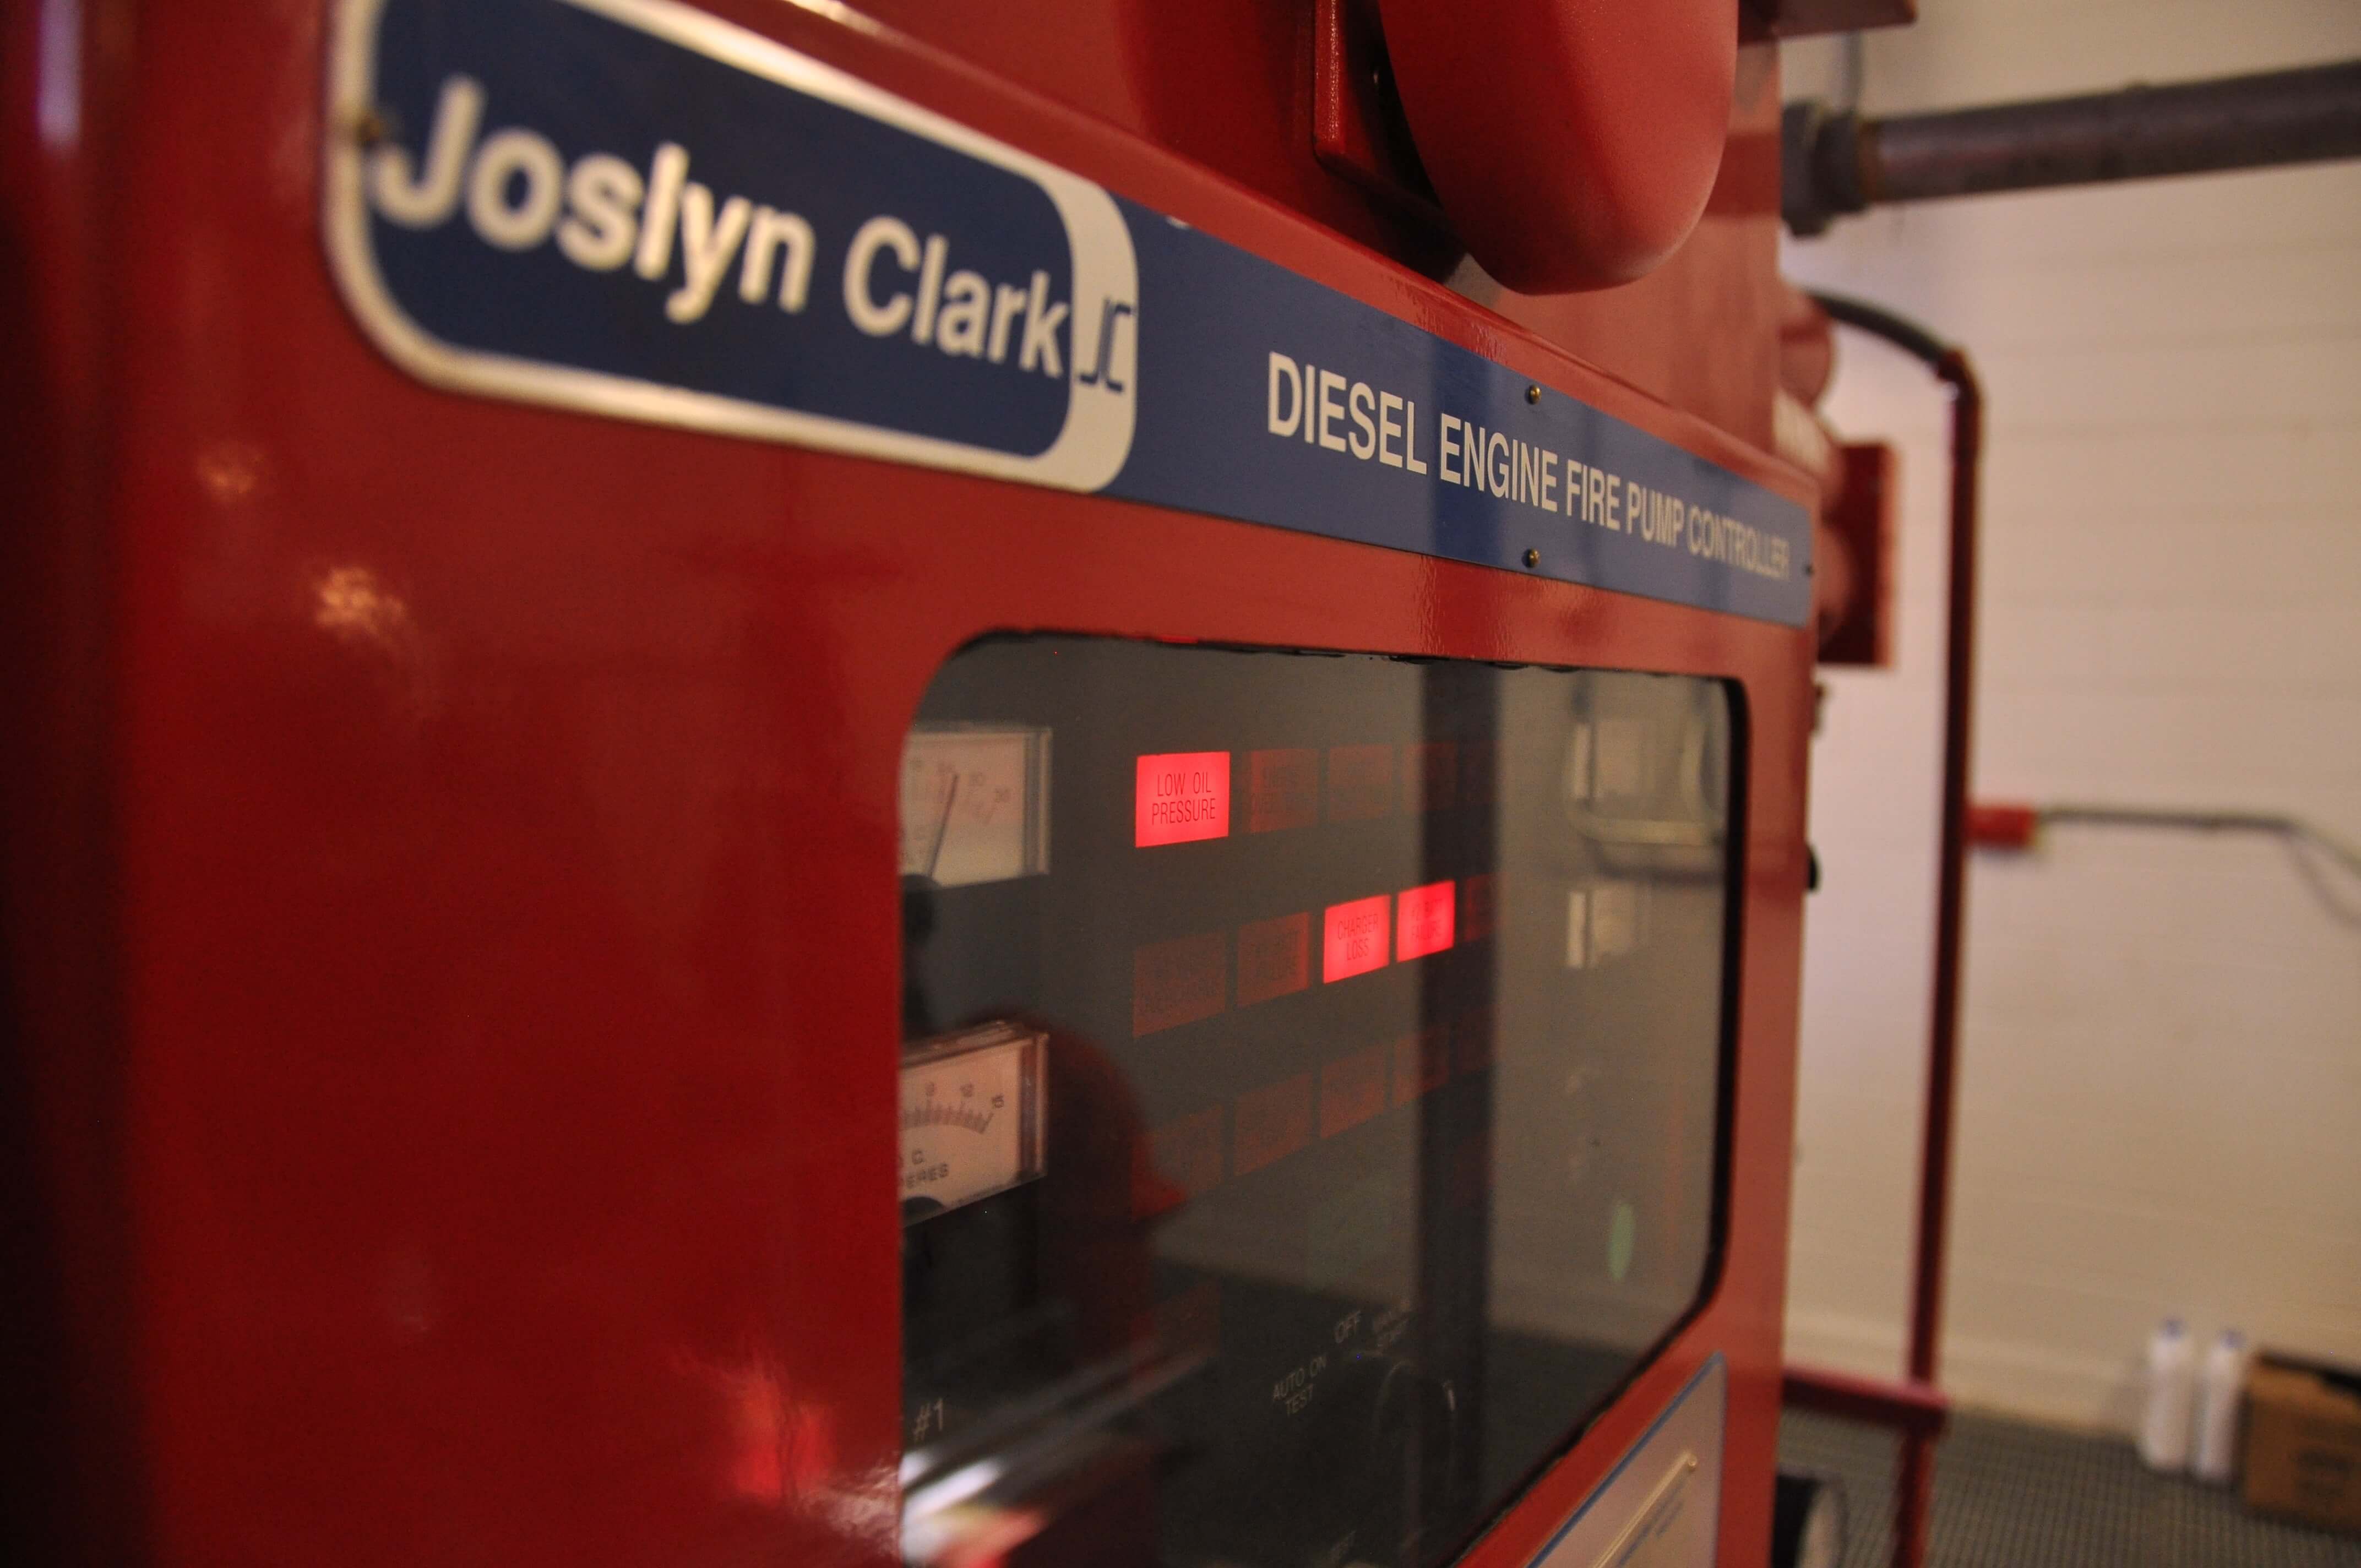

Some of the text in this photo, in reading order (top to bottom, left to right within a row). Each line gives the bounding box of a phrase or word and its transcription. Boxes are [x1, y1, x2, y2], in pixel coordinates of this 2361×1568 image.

[372, 73, 1071, 378] Joslyn Clark
[1268, 351, 1791, 582] DIESEL ENGINE FIRE PUMP CONTROLLER
[1157, 771, 1212, 797] LOW OIL
[1151, 798, 1216, 825] PRESSURE
[1337, 913, 1379, 940] CHARGER
[1346, 938, 1369, 961] LOSS
[1272, 1353, 1328, 1402] AUTO ON
[1285, 1383, 1315, 1418] TEST
[912, 1397, 944, 1443] #1
